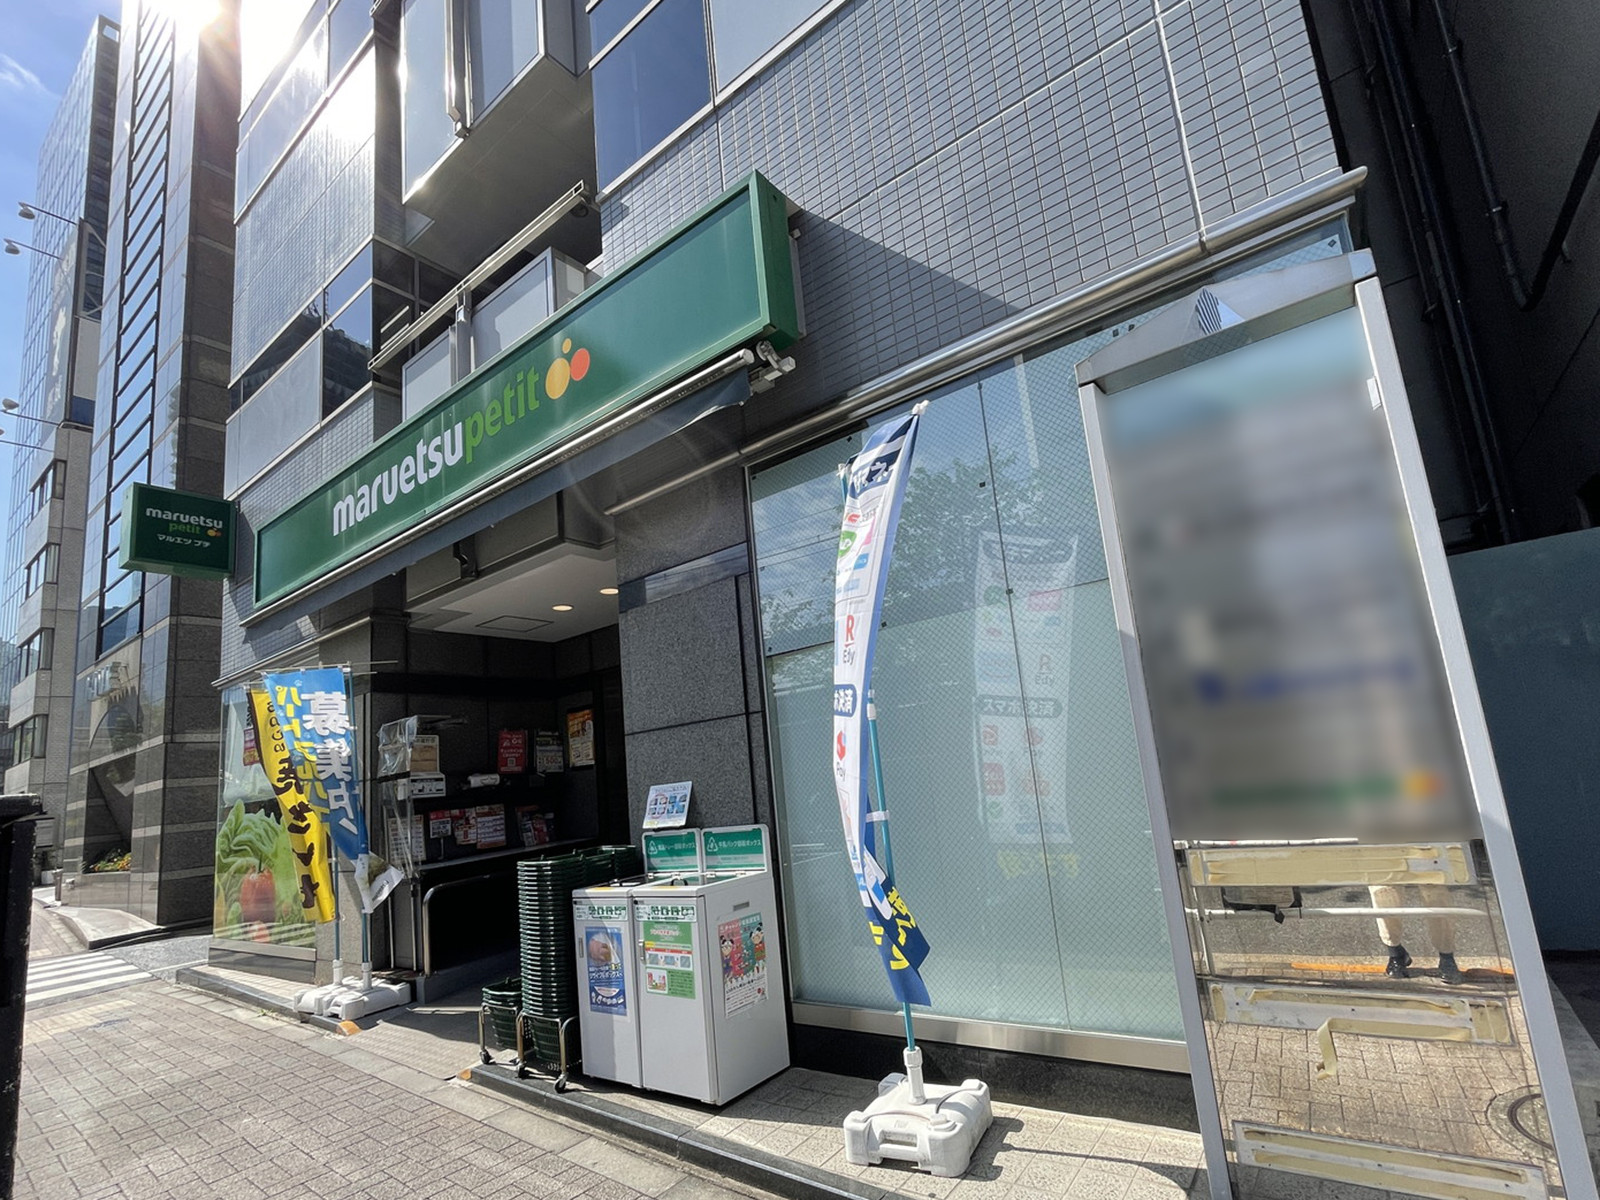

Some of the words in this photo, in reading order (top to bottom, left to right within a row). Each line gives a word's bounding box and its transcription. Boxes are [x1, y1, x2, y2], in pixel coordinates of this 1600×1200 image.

[333, 421, 463, 537] maruetsu
[464, 366, 540, 464] petit
[145, 507, 223, 529] maruetsu
[168, 522, 201, 534] petit
[156, 533, 192, 546] マルエツ
